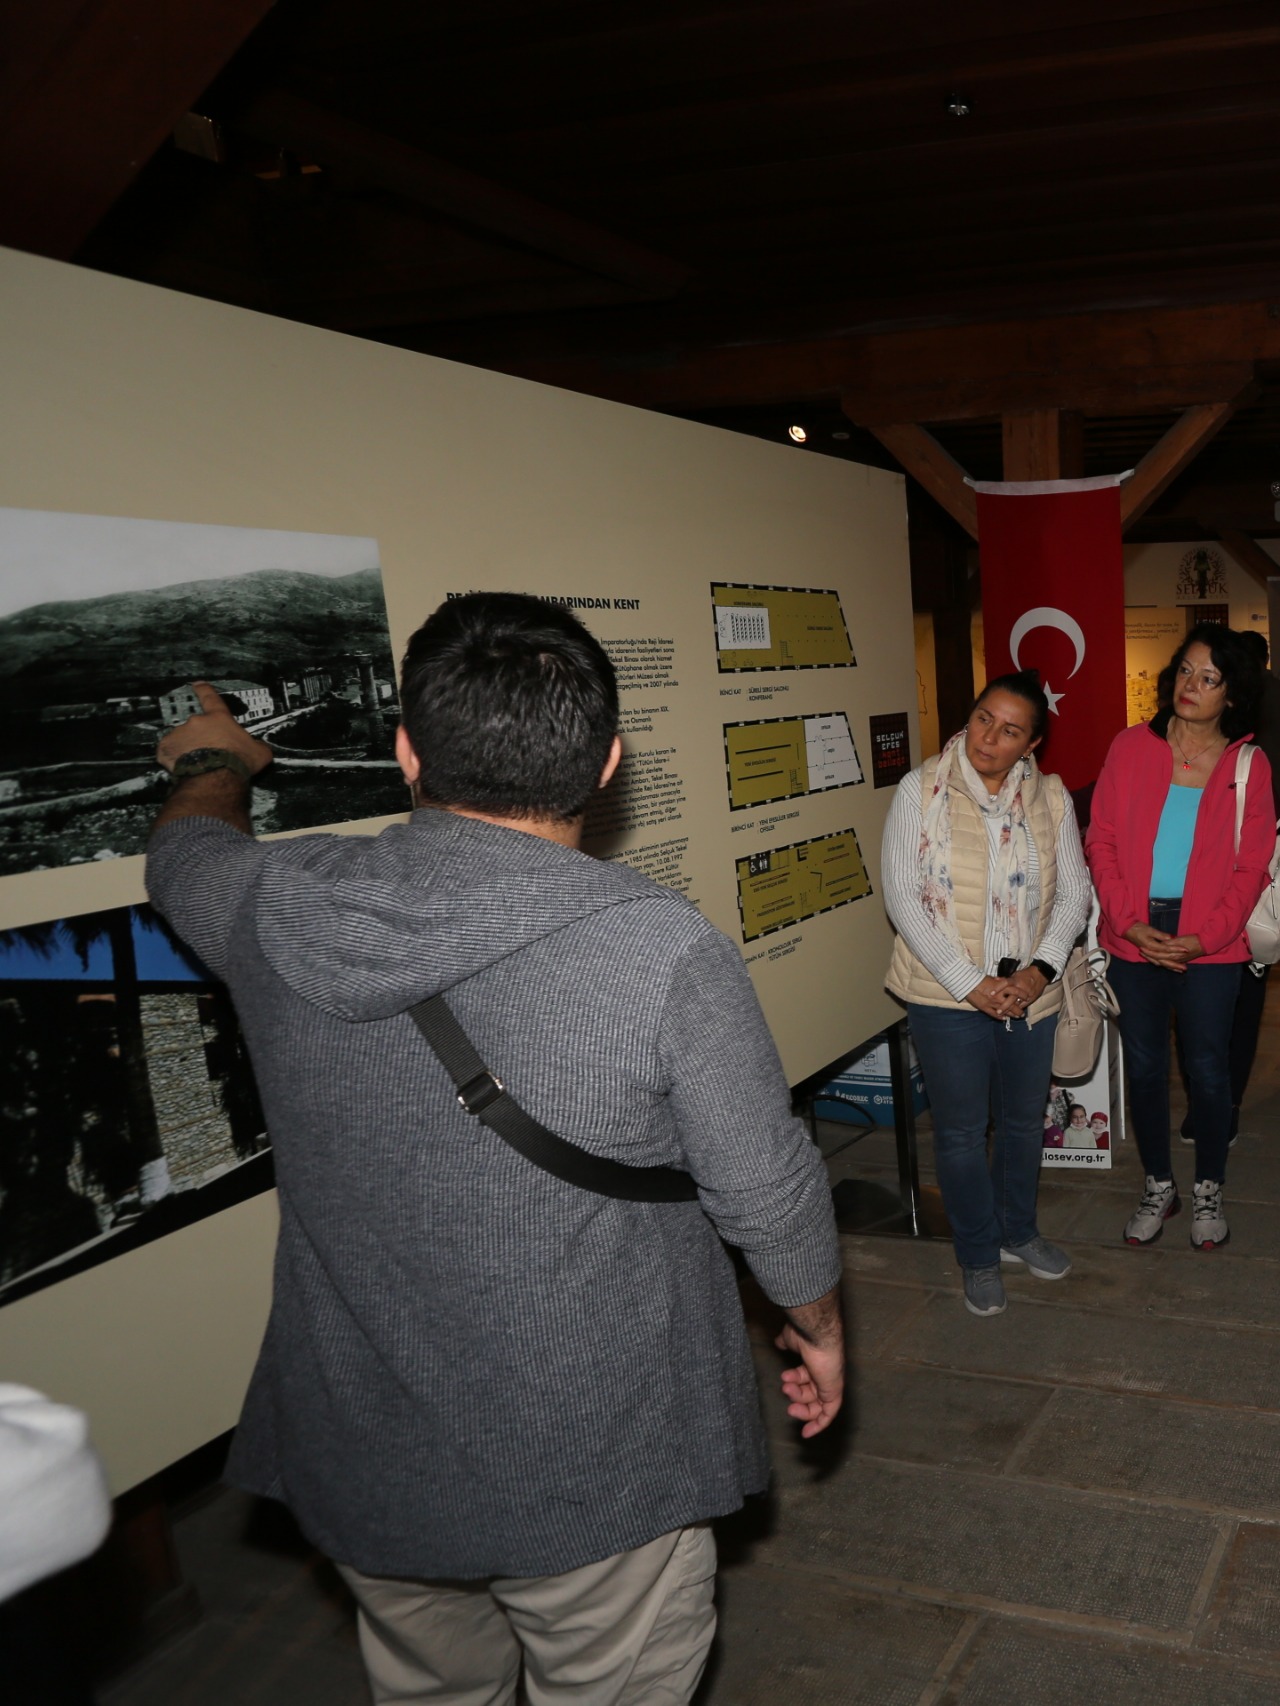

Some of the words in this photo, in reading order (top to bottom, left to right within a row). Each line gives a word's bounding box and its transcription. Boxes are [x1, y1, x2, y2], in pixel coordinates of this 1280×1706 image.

[539, 596, 610, 609] MBARINDAN
[614, 598, 640, 610] KENT
[876, 731, 904, 742] SELÇUK
[881, 741, 900, 750] EFES
[1042, 1152, 1105, 1164] .losev.org.tr
